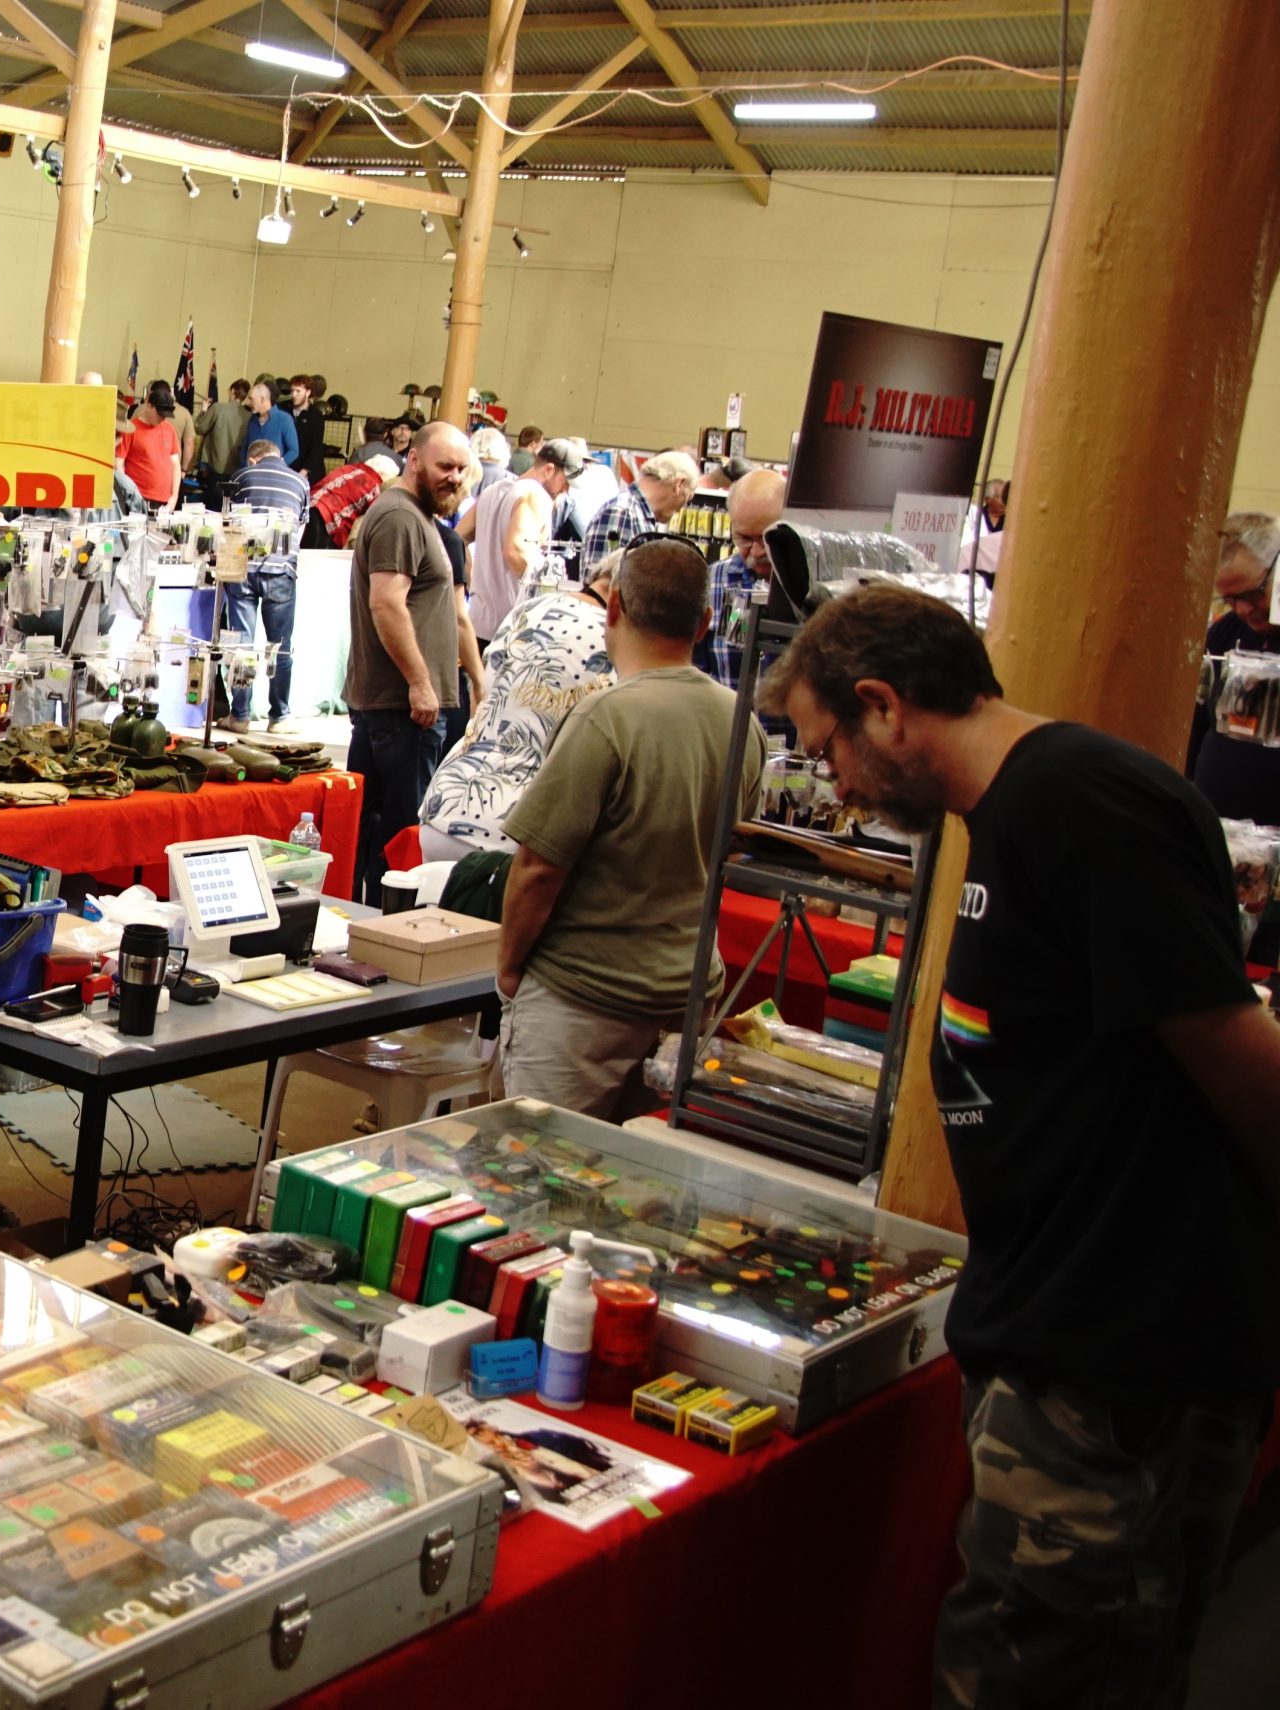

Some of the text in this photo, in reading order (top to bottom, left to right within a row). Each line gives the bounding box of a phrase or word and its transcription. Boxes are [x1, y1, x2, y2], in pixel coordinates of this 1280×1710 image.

[870, 386, 976, 439] MILITARIA
[901, 511, 958, 533] 303 PARTS
[946, 1108, 984, 1126] MOON
[812, 1265, 958, 1335] DO NOT LEAN ON GLASS
[271, 1474, 315, 1497] PMC
[103, 1600, 150, 1626] DO
[150, 1572, 207, 1605] NOT
[209, 1543, 279, 1578] LEAN
[320, 1494, 395, 1532] GLASS
